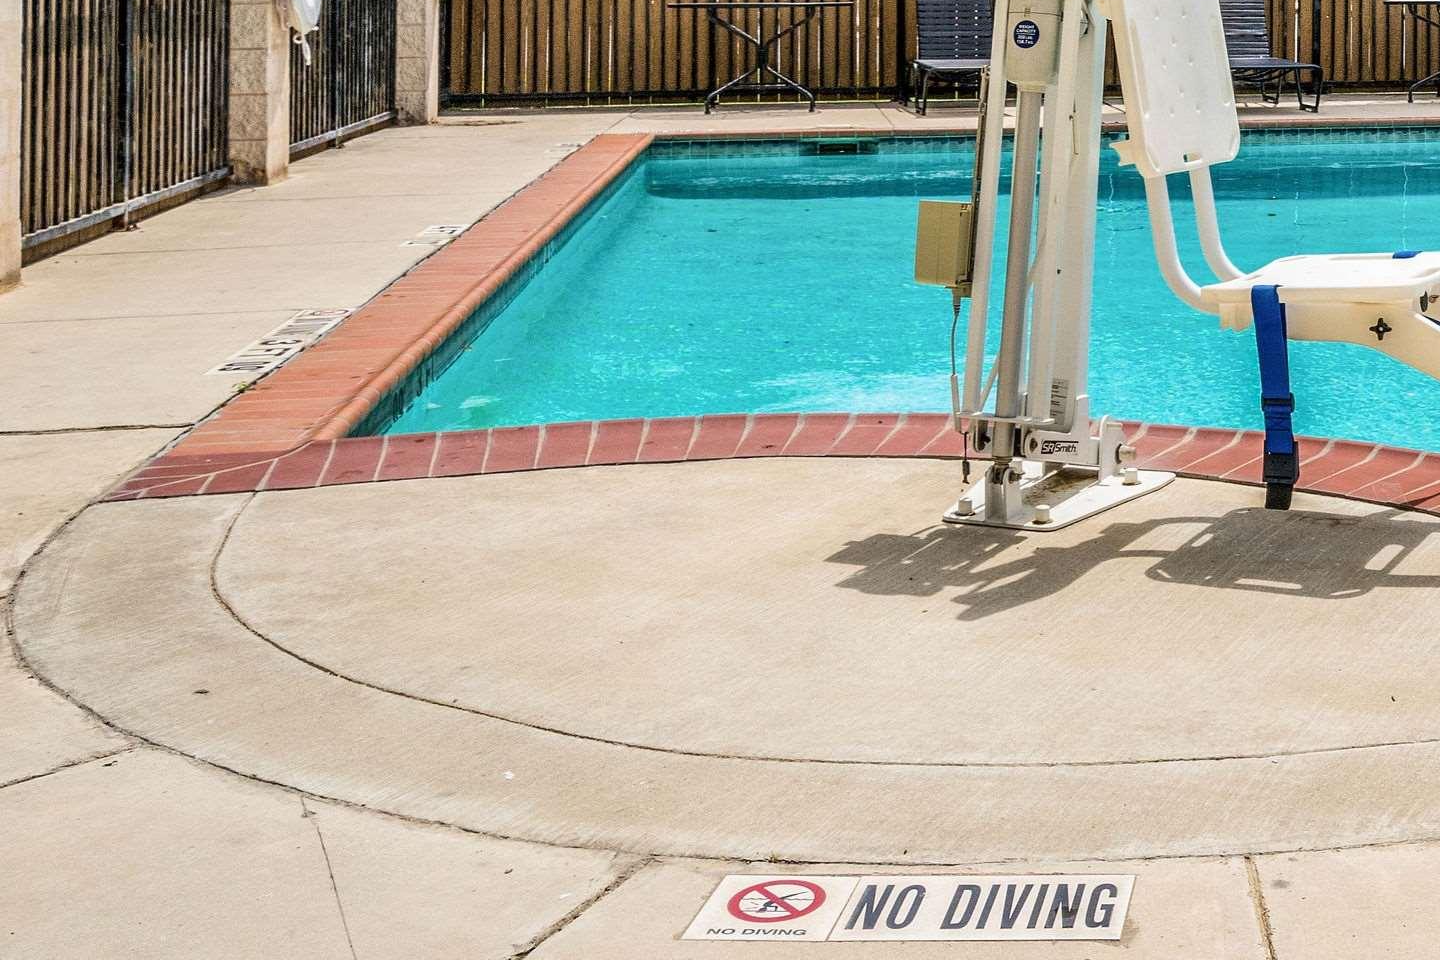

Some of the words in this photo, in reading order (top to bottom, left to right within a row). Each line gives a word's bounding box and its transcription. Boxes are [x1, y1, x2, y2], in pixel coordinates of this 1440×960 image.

[843, 883, 926, 930] NO
[940, 883, 1119, 929] DIVING
[741, 928, 808, 936] DIVING
